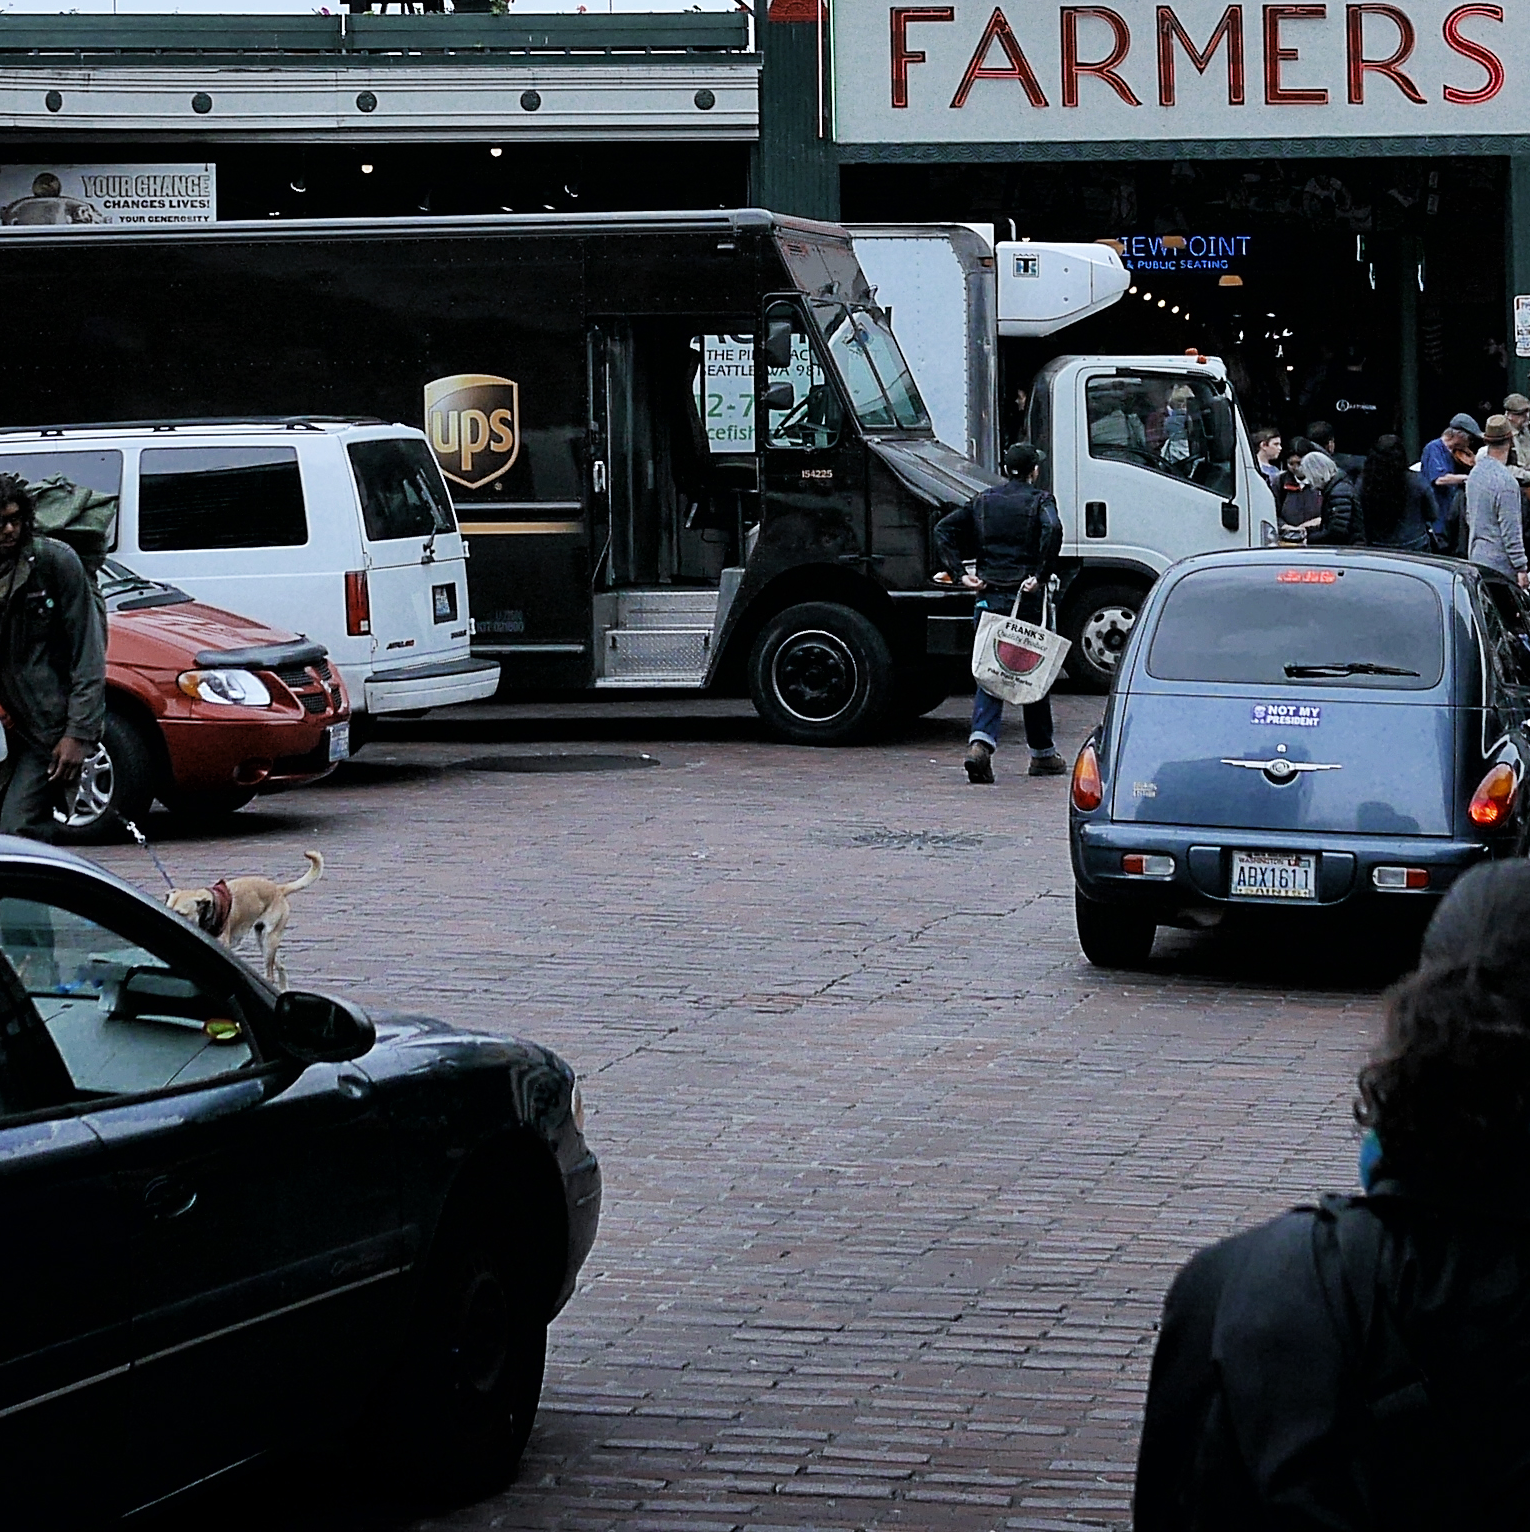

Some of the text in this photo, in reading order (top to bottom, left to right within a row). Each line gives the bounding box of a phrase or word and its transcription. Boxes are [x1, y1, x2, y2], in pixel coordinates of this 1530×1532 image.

[889, 3, 1506, 110] FARMERS
[80, 174, 211, 198] YOUR CHANGE
[103, 199, 211, 209] CHANGES LIVES!
[119, 215, 145, 223] YOUR
[1119, 235, 1252, 257] IEWOINT
[1138, 260, 1177, 270] PUBLIC
[1180, 259, 1229, 269] SEATING
[707, 350, 733, 361] THE
[705, 365, 755, 376] EATTLE
[432, 408, 514, 471] ups
[1005, 621, 1046, 641] FRANK'S
[1267, 705, 1320, 717] NOT MY
[1266, 716, 1320, 726] PRESIDENT
[1237, 866, 1309, 888] ABX1611
